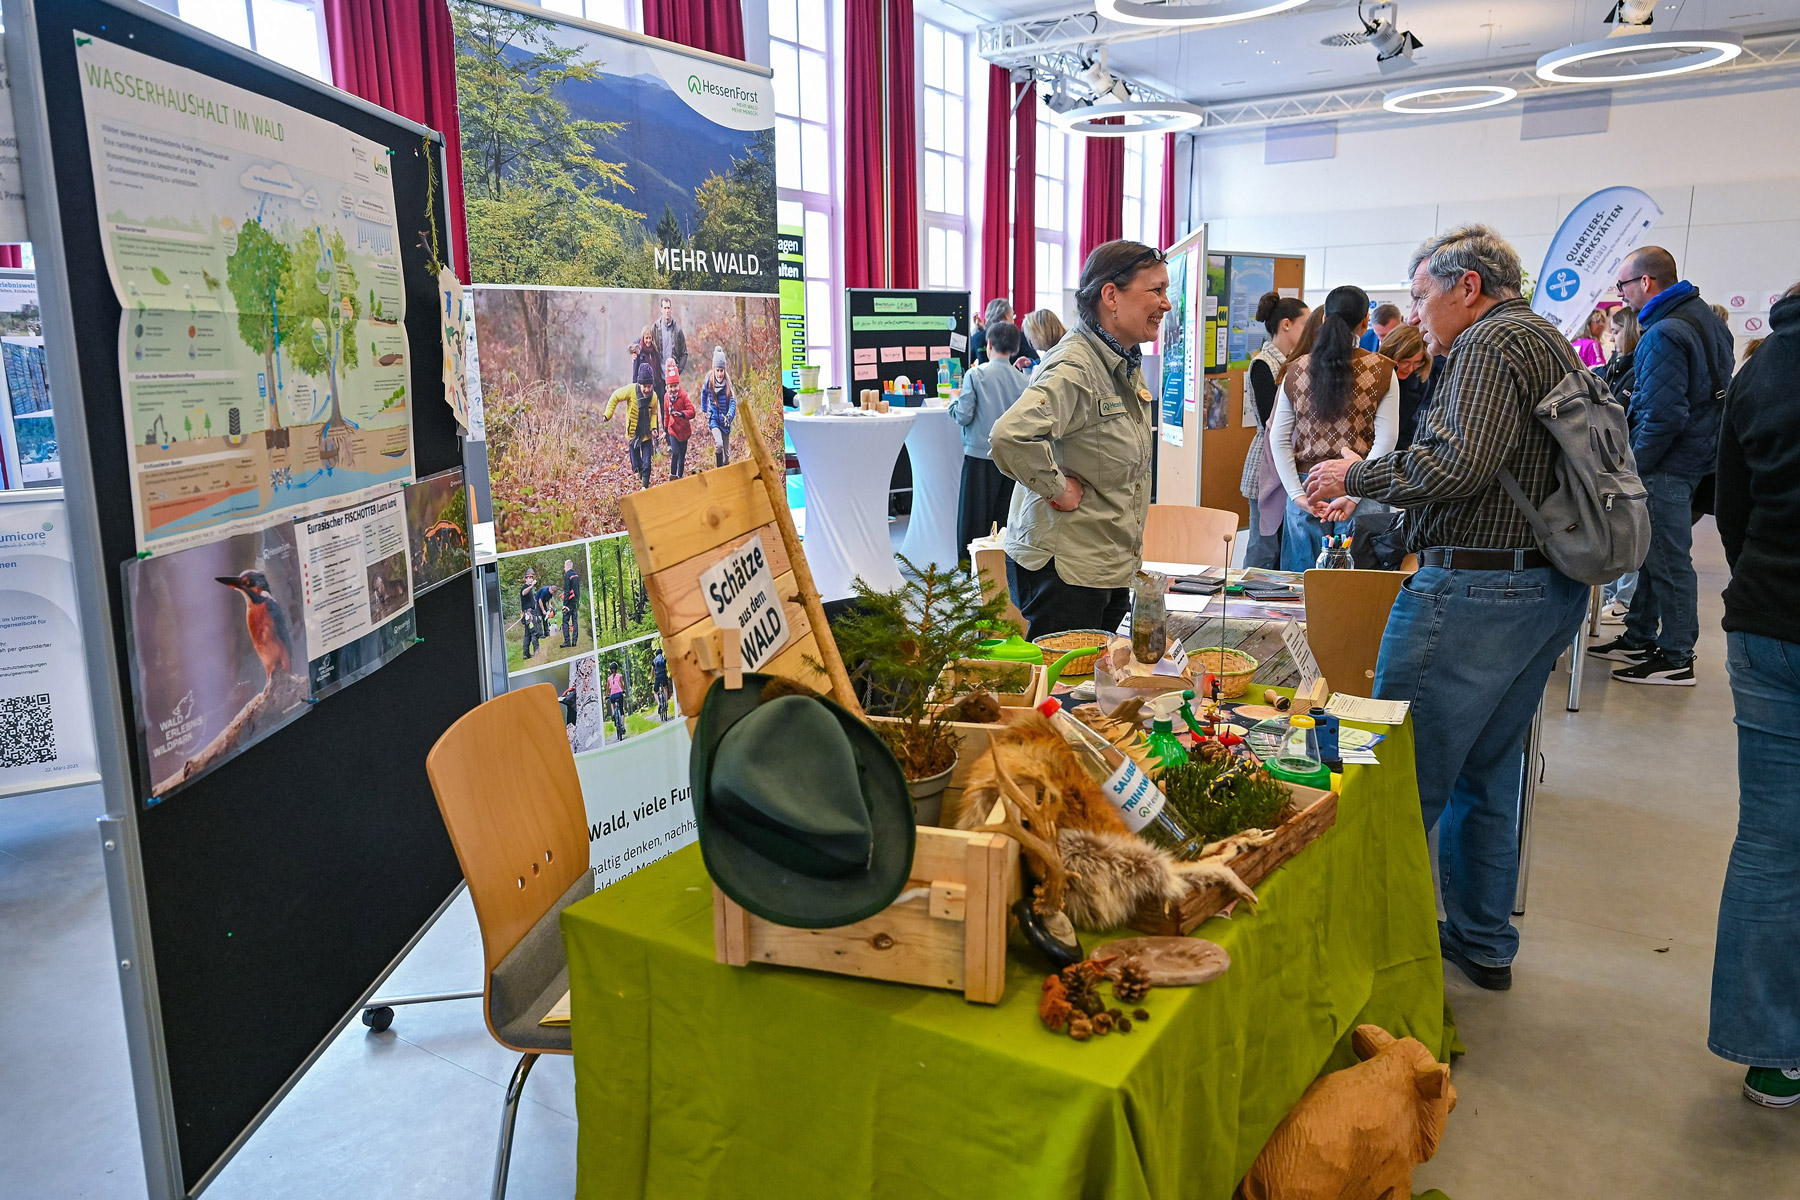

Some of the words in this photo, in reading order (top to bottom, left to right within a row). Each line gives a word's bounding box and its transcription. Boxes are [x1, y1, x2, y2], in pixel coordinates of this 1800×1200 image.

[84, 61, 229, 125] WASSERHAUSHALT
[233, 109, 249, 131] IM
[252, 114, 284, 142] WALD
[702, 80, 758, 103] HessenForst
[1566, 210, 1606, 262] QUARTIERS-
[1574, 204, 1624, 267] WERKSTÄTTEN
[654, 247, 709, 272] MEHR
[712, 251, 763, 276] WALD.
[1583, 245, 1608, 273] Hanau
[307, 515, 344, 535] Eurasischer
[344, 503, 377, 524] FISCHOTTER
[709, 547, 764, 614] Schätze
[738, 607, 752, 628] aus
[750, 590, 767, 614] dem
[740, 607, 782, 669] WALD
[159, 715, 184, 732] WALD
[152, 732, 193, 758] WILDPARK
[588, 810, 630, 842] Wald,
[632, 796, 667, 821] viele
[623, 837, 663, 862] denken,
